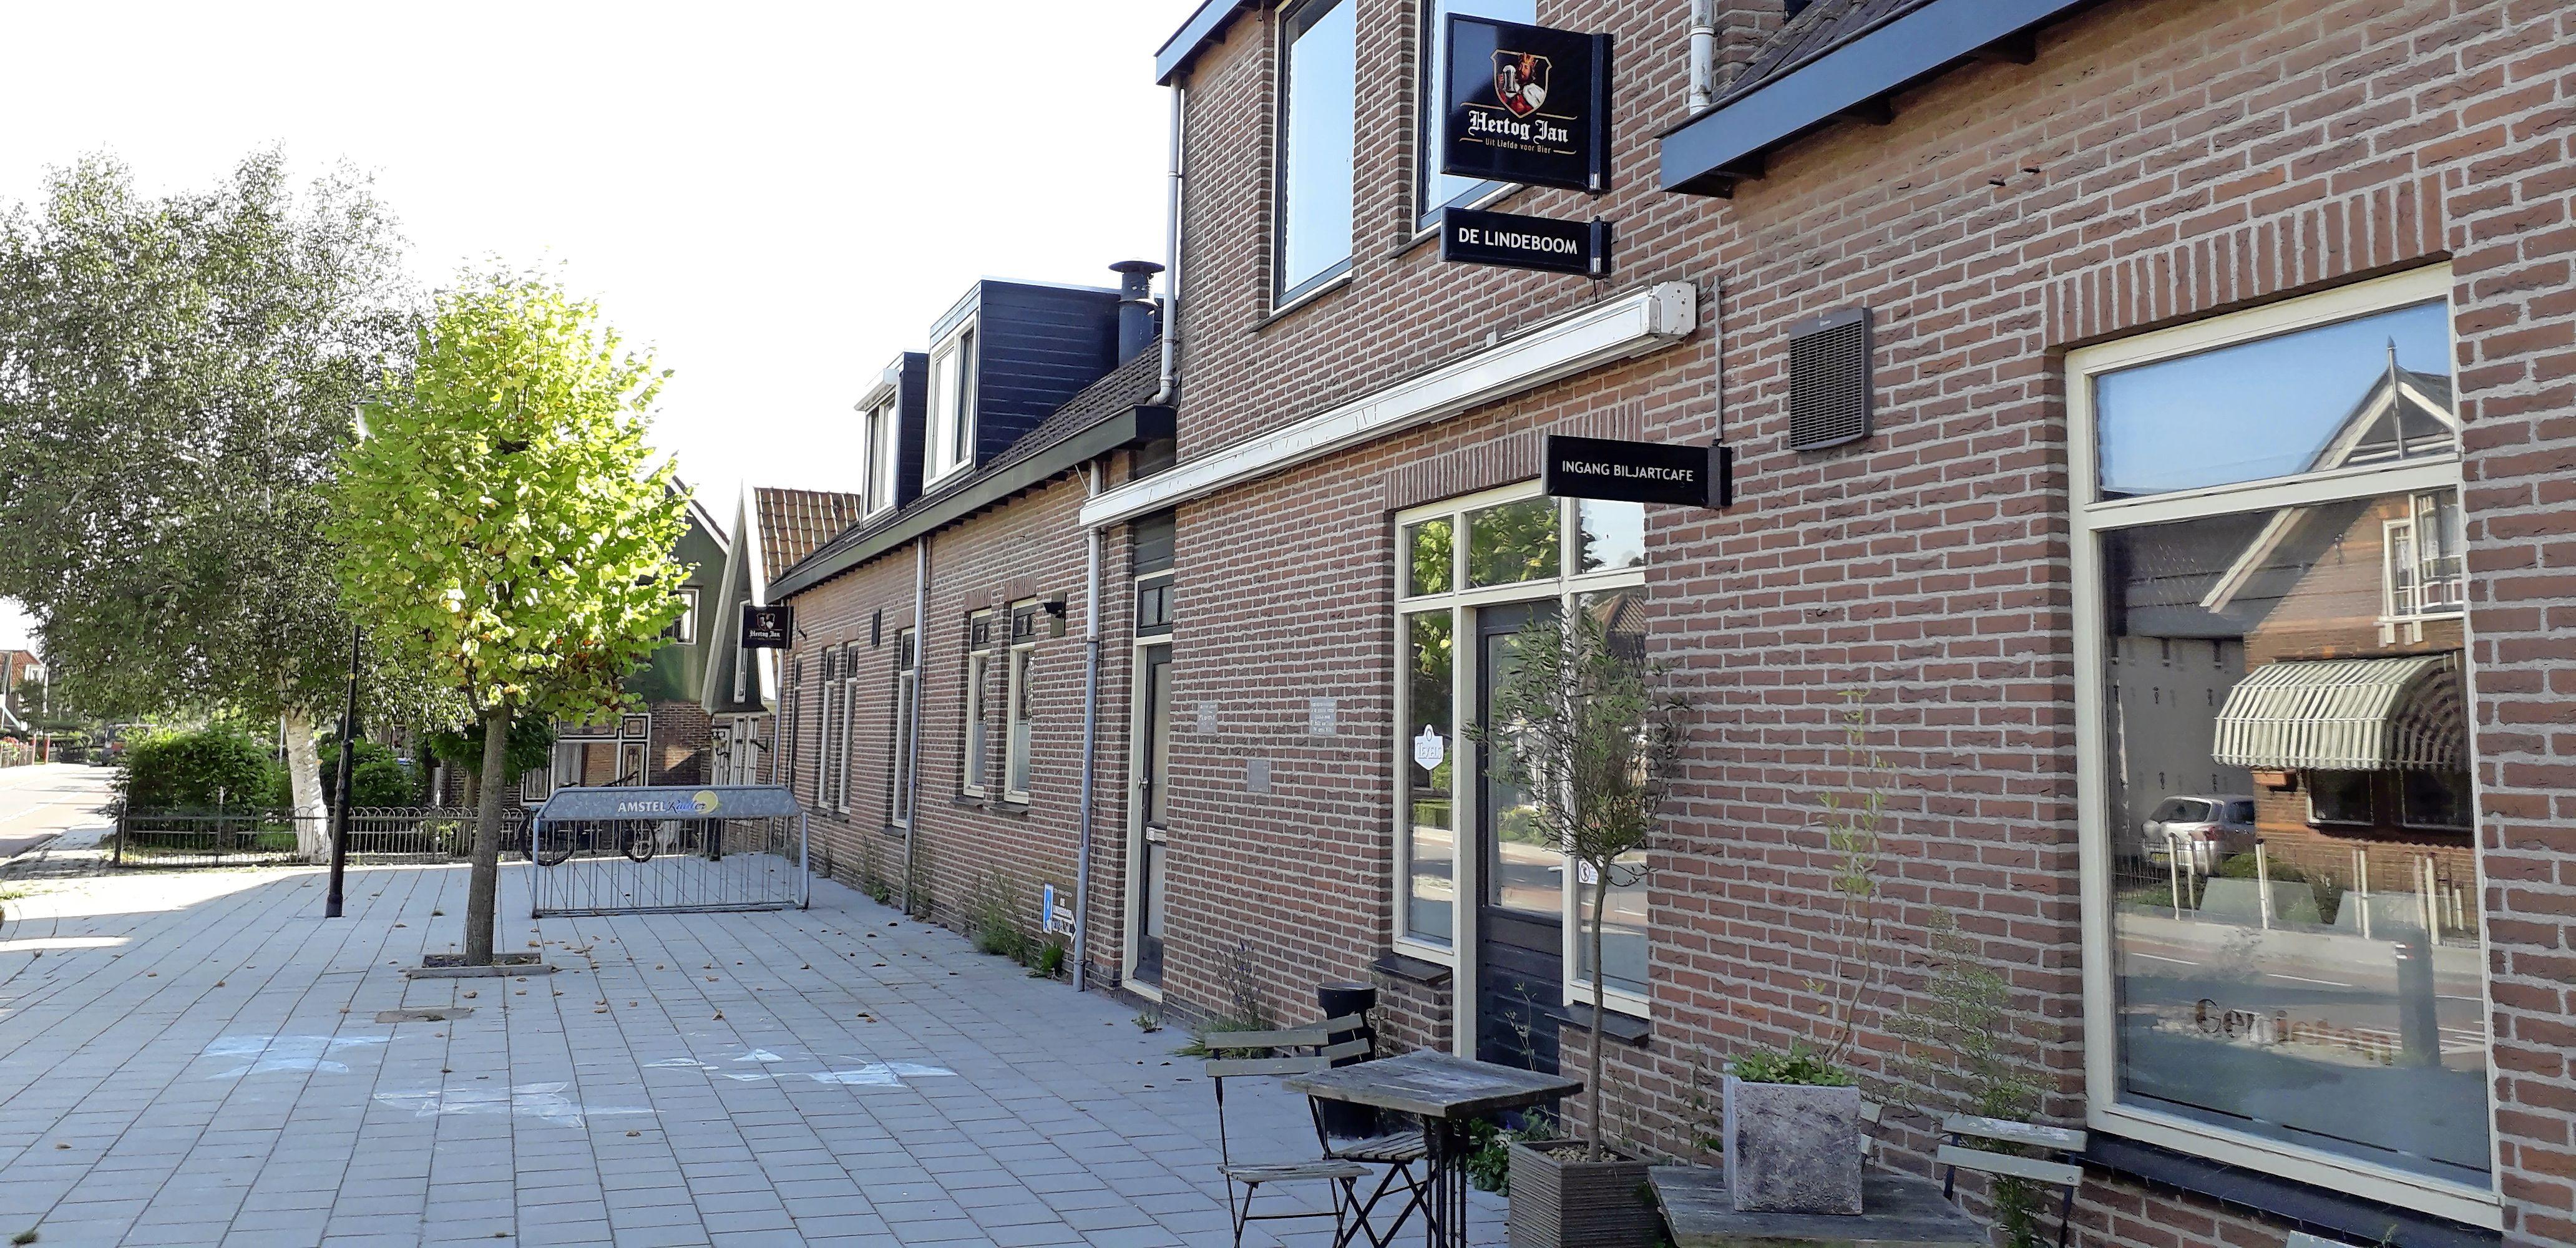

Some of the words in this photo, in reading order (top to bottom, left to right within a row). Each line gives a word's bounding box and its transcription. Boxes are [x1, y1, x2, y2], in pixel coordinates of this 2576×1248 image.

[1468, 110, 1530, 140] Hertog
[1533, 120, 1568, 144] Jan
[1485, 137, 1495, 147] Uit
[1498, 139, 1518, 149] Liefde
[1520, 144, 1534, 152] voor
[1537, 145, 1551, 154] Bier
[1458, 228, 1479, 244] DE
[1485, 230, 1578, 255] LINDEBOOM
[1562, 460, 1610, 475] INGANG
[1614, 464, 1694, 482] BILJARTCAFE
[749, 630, 768, 638] Hertog
[617, 801, 666, 812] AMSTEL
[666, 799, 706, 814] Radler
